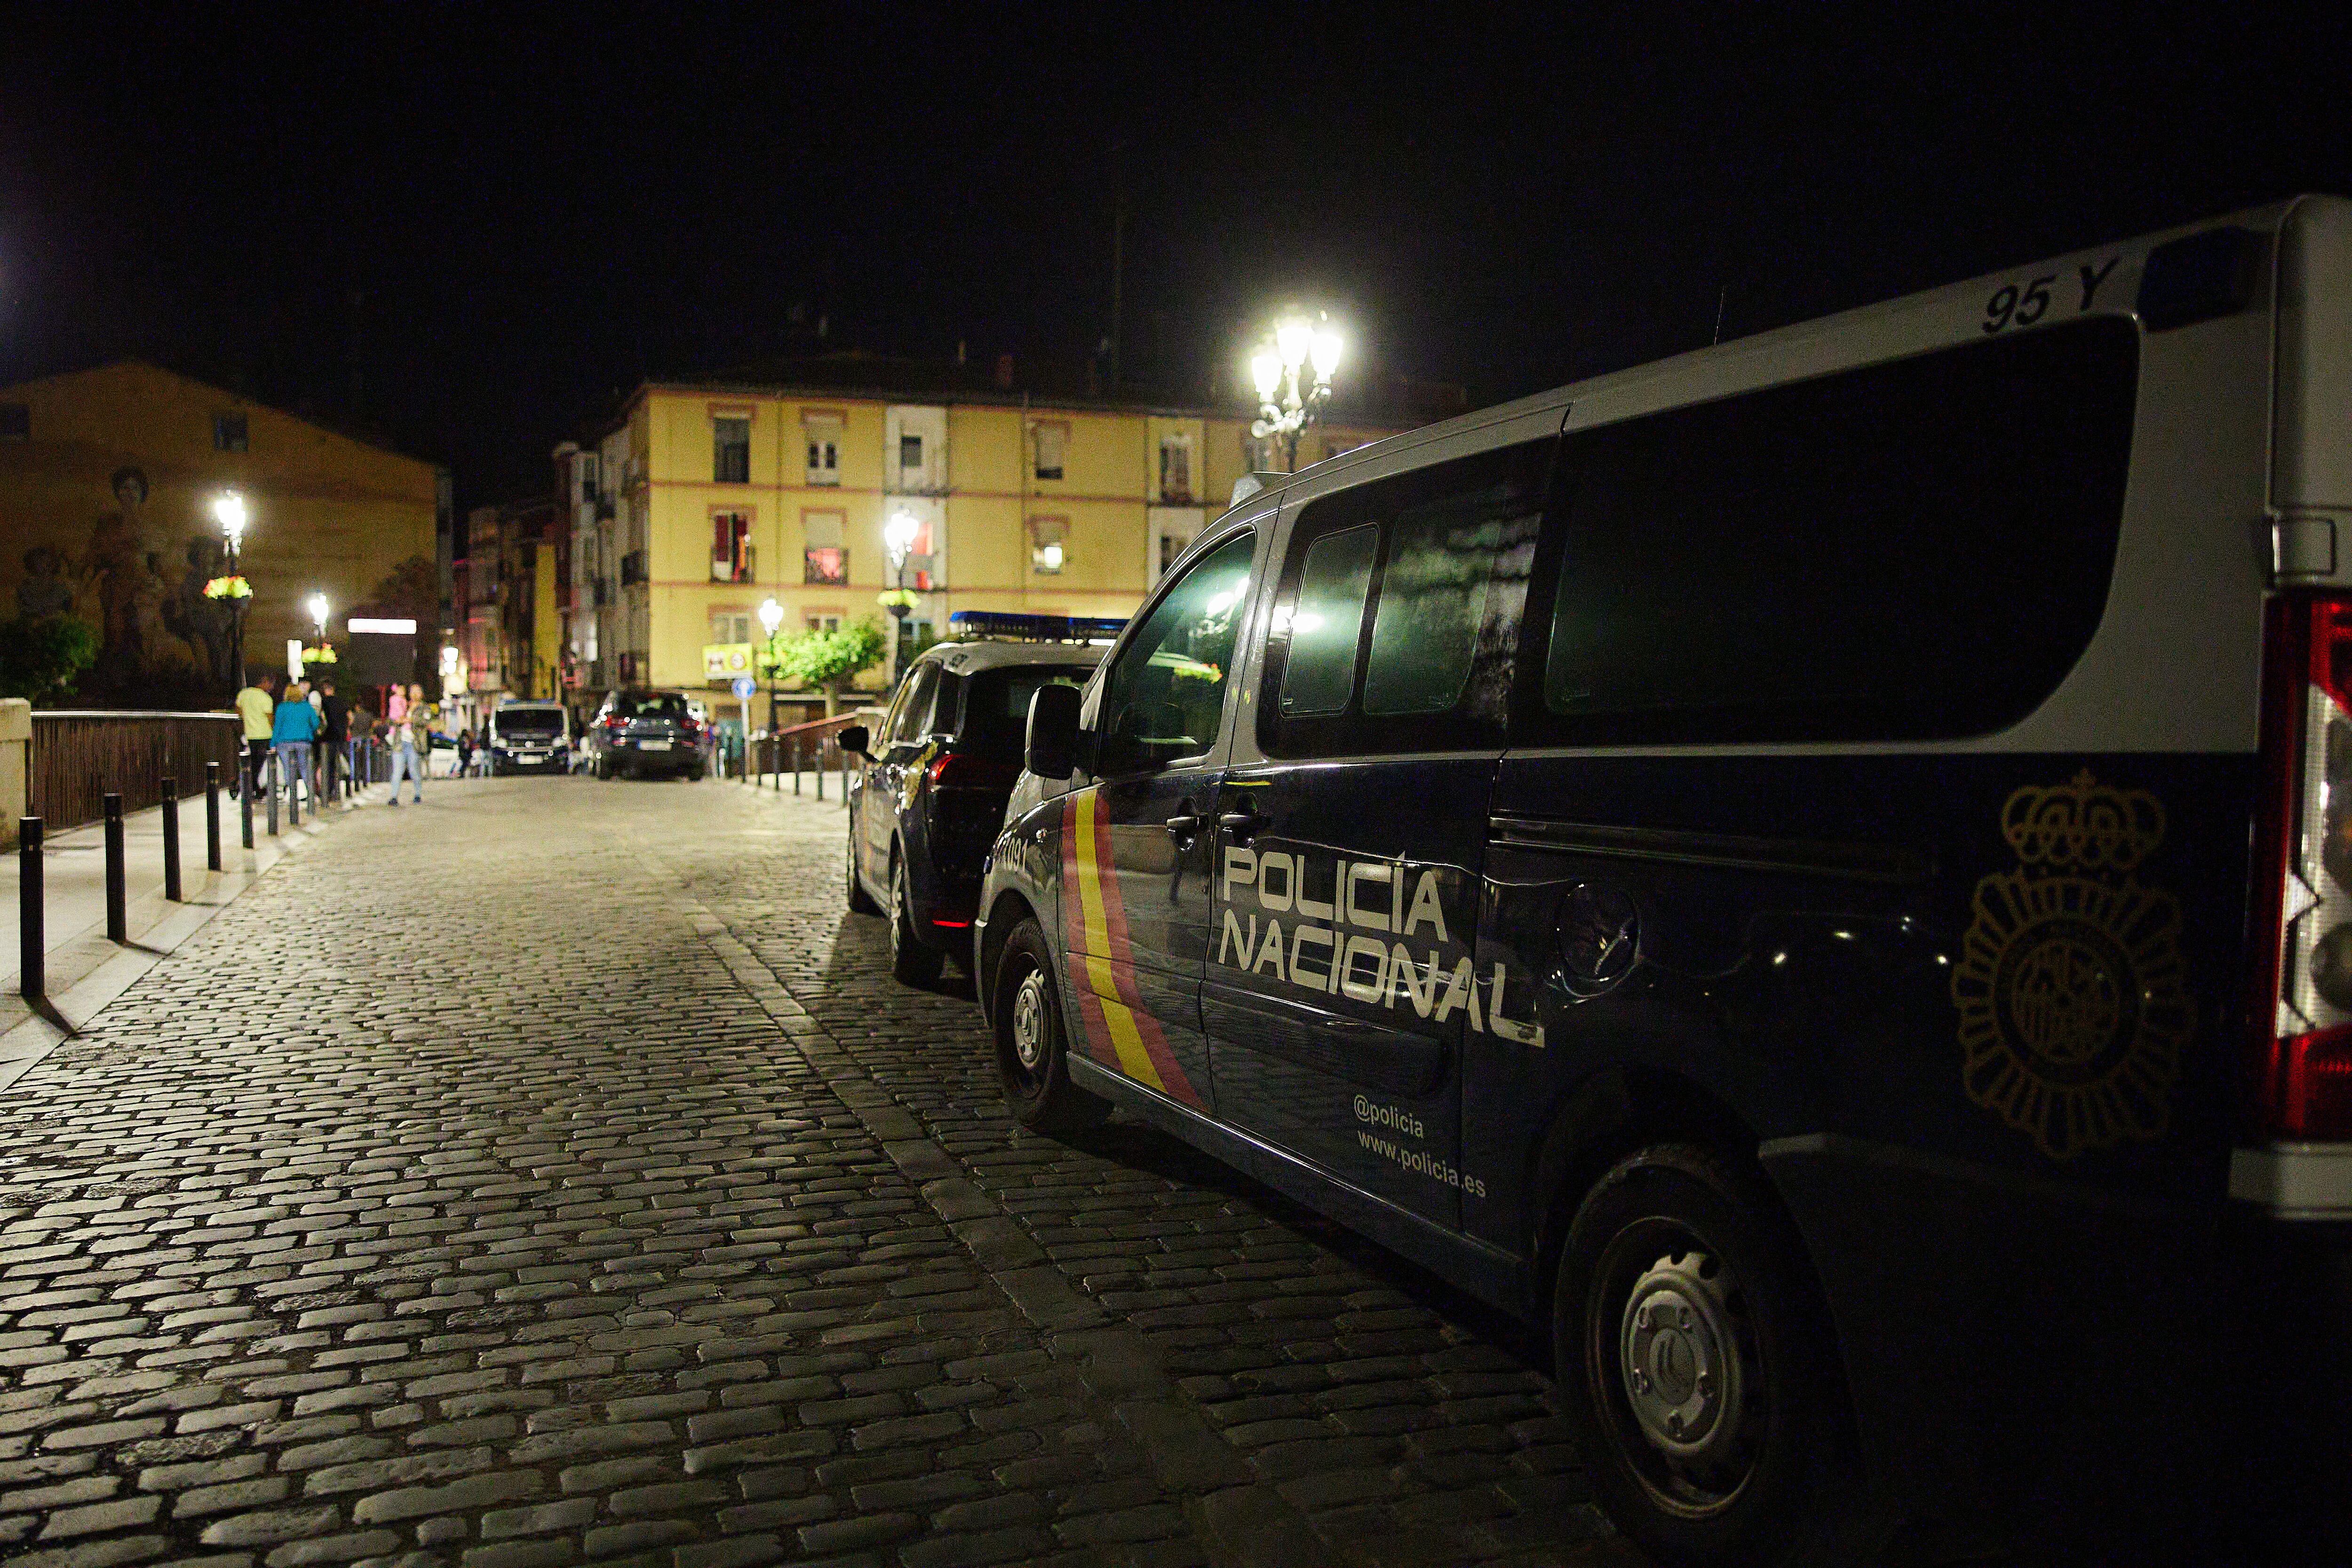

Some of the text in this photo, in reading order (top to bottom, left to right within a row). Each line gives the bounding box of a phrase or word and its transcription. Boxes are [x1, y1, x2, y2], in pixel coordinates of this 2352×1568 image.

[1982, 257, 2121, 332] 95 Y
[1223, 846, 1448, 943] POLICÍA
[1218, 908, 1545, 1048] NACIONAL
[1354, 1094, 1423, 1139] @policia
[1358, 1129, 1486, 1198] www.policia.es
